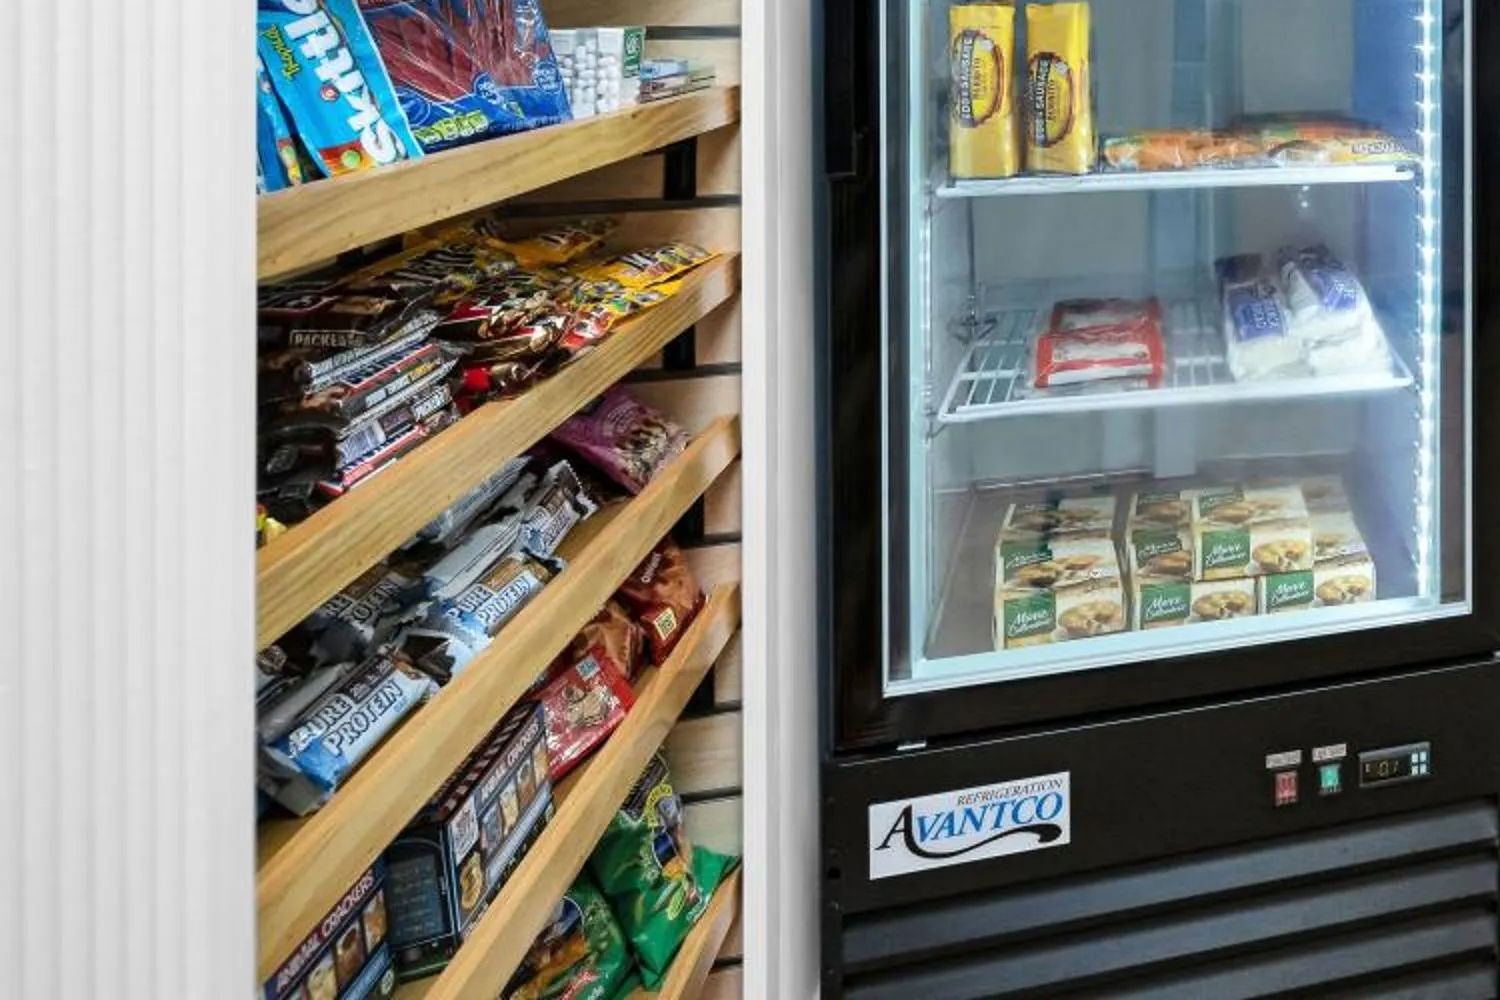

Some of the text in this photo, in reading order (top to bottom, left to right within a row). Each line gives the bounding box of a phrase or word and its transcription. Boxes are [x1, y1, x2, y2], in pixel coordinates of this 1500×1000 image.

[476, 574, 531, 623] PROTEIN
[321, 679, 405, 757] PROTEIN
[956, 778, 1065, 808] REFRIGERATION
[874, 790, 1064, 858] AVANTCO
